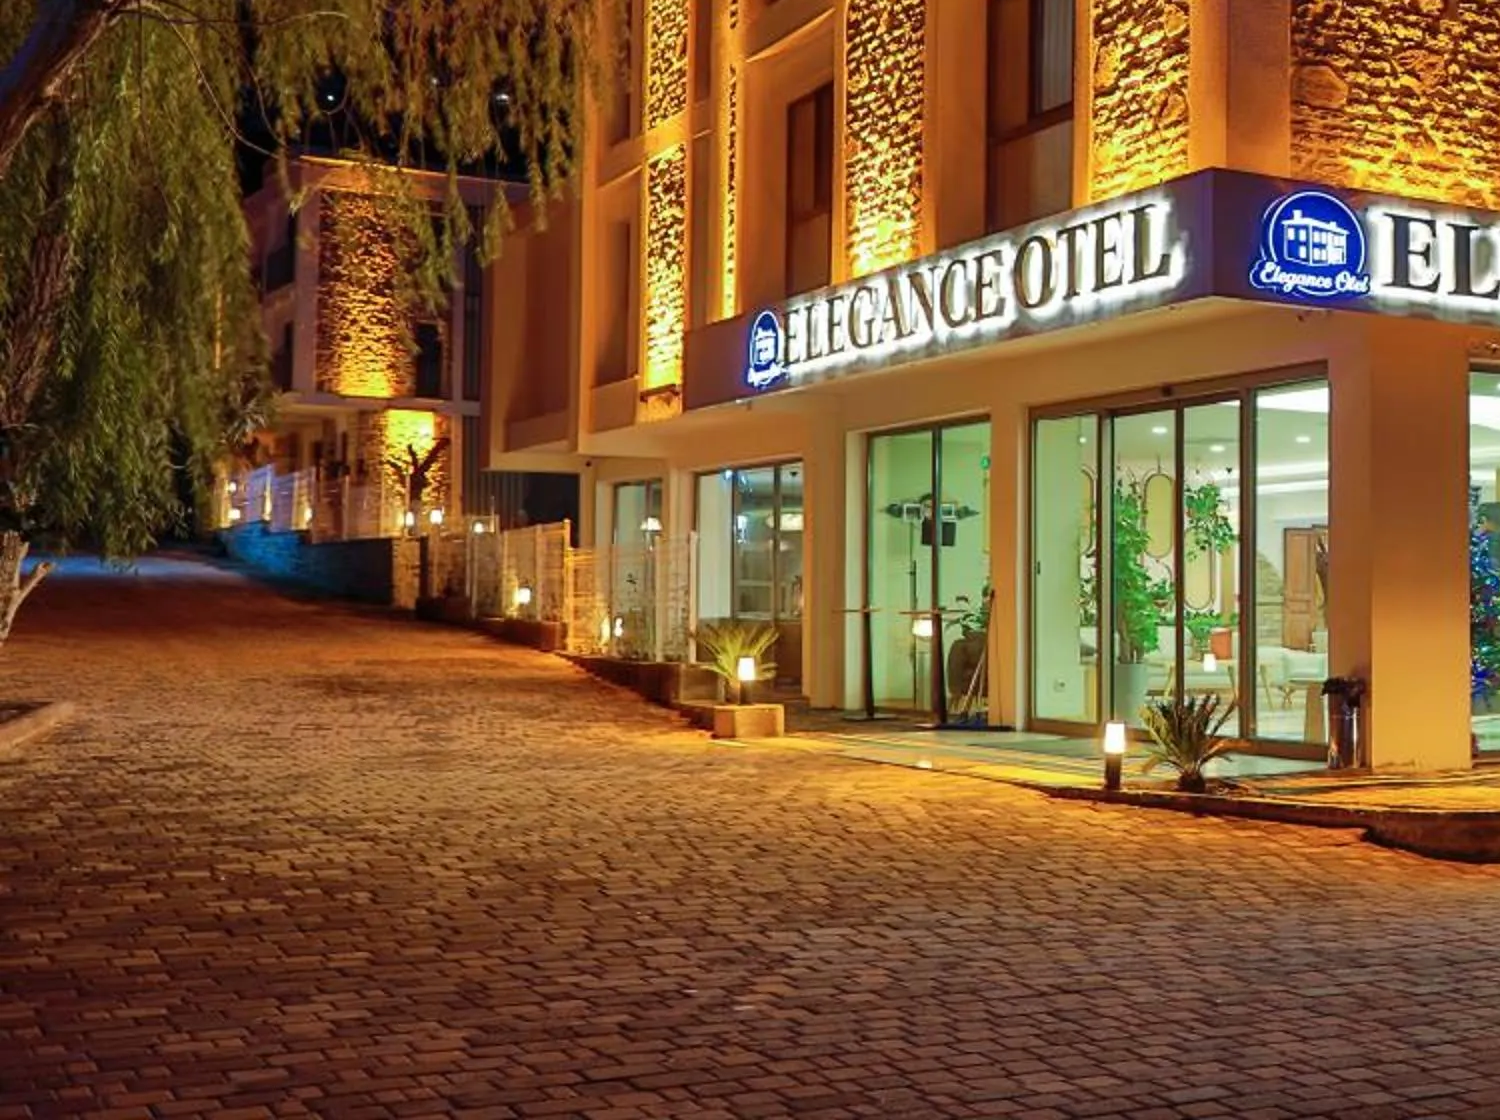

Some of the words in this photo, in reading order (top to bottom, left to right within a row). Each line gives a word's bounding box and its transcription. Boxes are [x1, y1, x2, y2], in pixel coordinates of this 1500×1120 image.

[781, 250, 1007, 368] ELEGANCE
[1012, 203, 1172, 310] OTEL
[1260, 261, 1333, 292] Elegance
